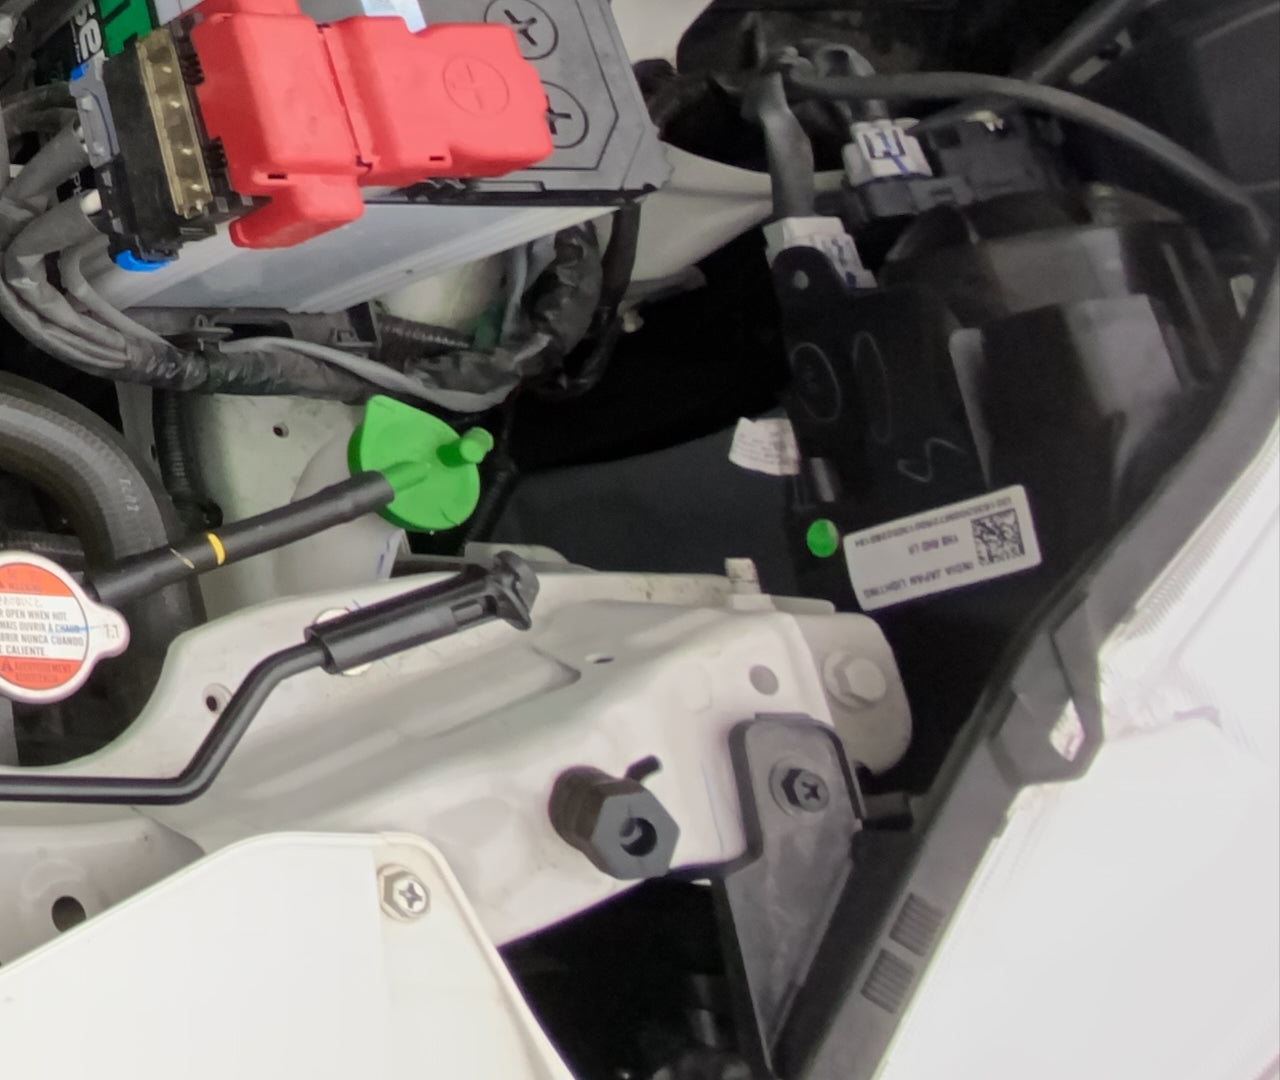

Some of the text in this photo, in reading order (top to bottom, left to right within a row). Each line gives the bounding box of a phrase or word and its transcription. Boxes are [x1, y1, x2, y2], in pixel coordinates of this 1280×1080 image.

[5, 609, 26, 619] OPEN
[28, 610, 50, 620] WHEN
[19, 621, 46, 632] OUVRIR
[21, 633, 48, 644] NUNCA
[51, 635, 84, 647] CUANDO
